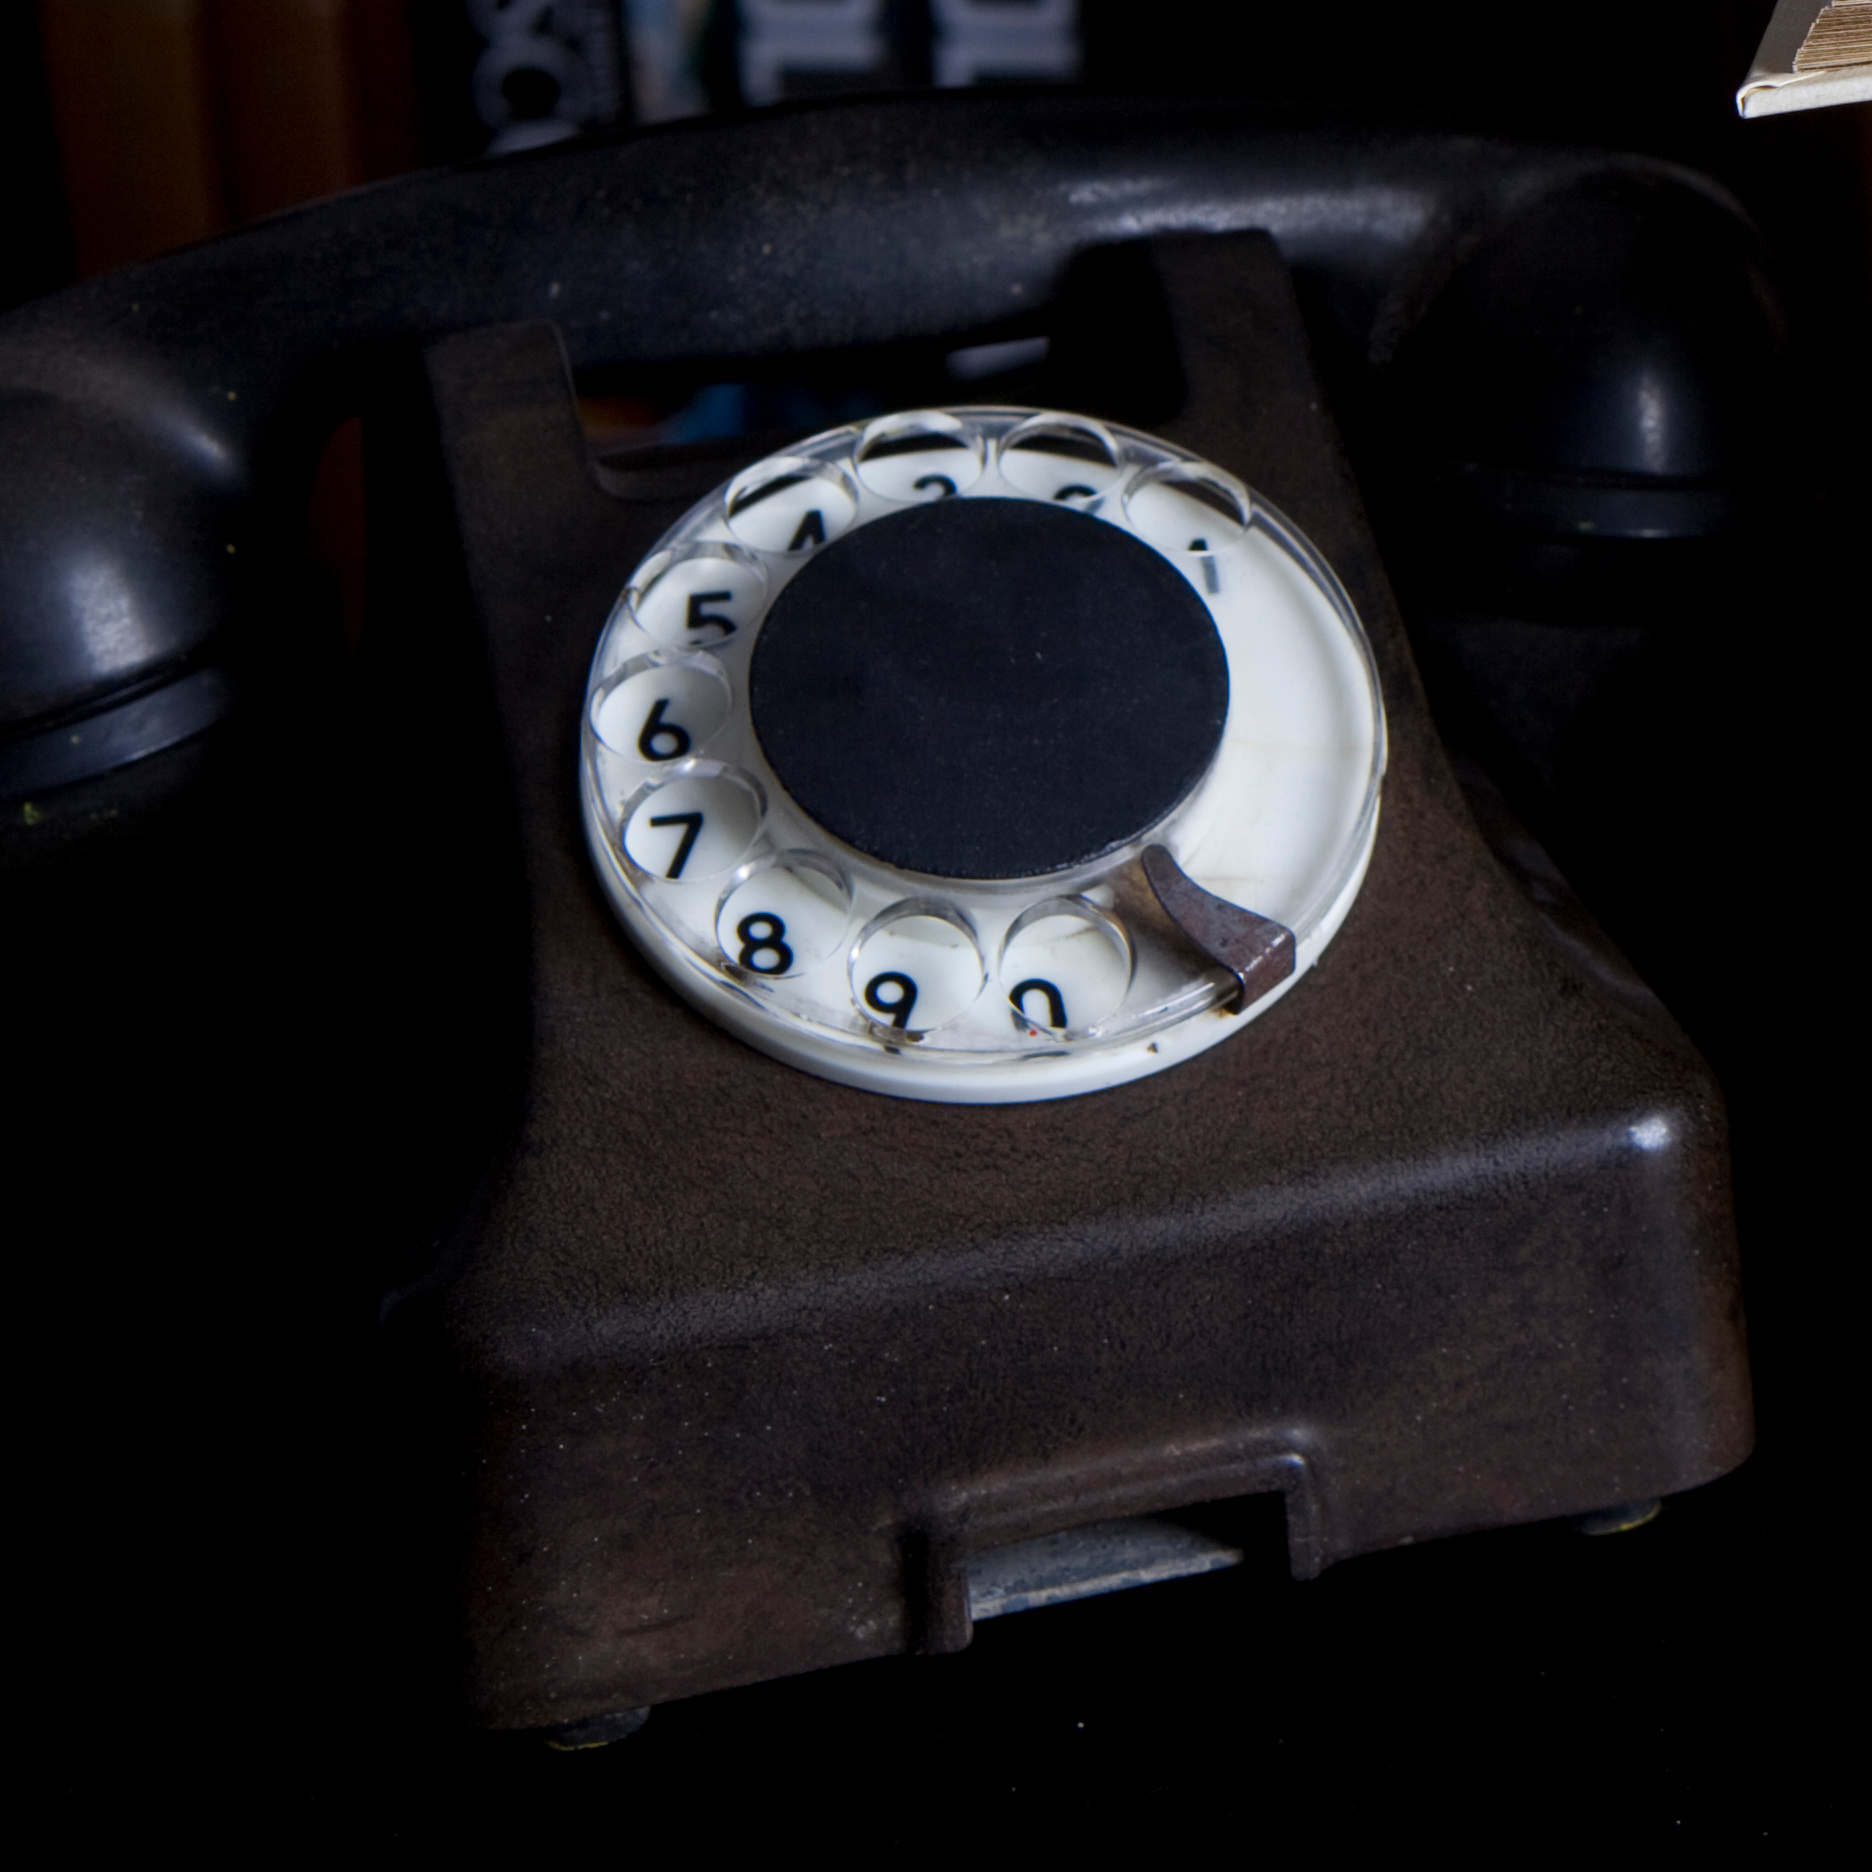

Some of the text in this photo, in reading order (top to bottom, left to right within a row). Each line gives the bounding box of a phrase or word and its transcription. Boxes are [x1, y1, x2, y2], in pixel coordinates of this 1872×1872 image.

[685, 590, 736, 645] 5
[637, 698, 690, 762] 6
[649, 812, 704, 879] 7
[736, 911, 794, 975] 8
[864, 971, 918, 1030] 9
